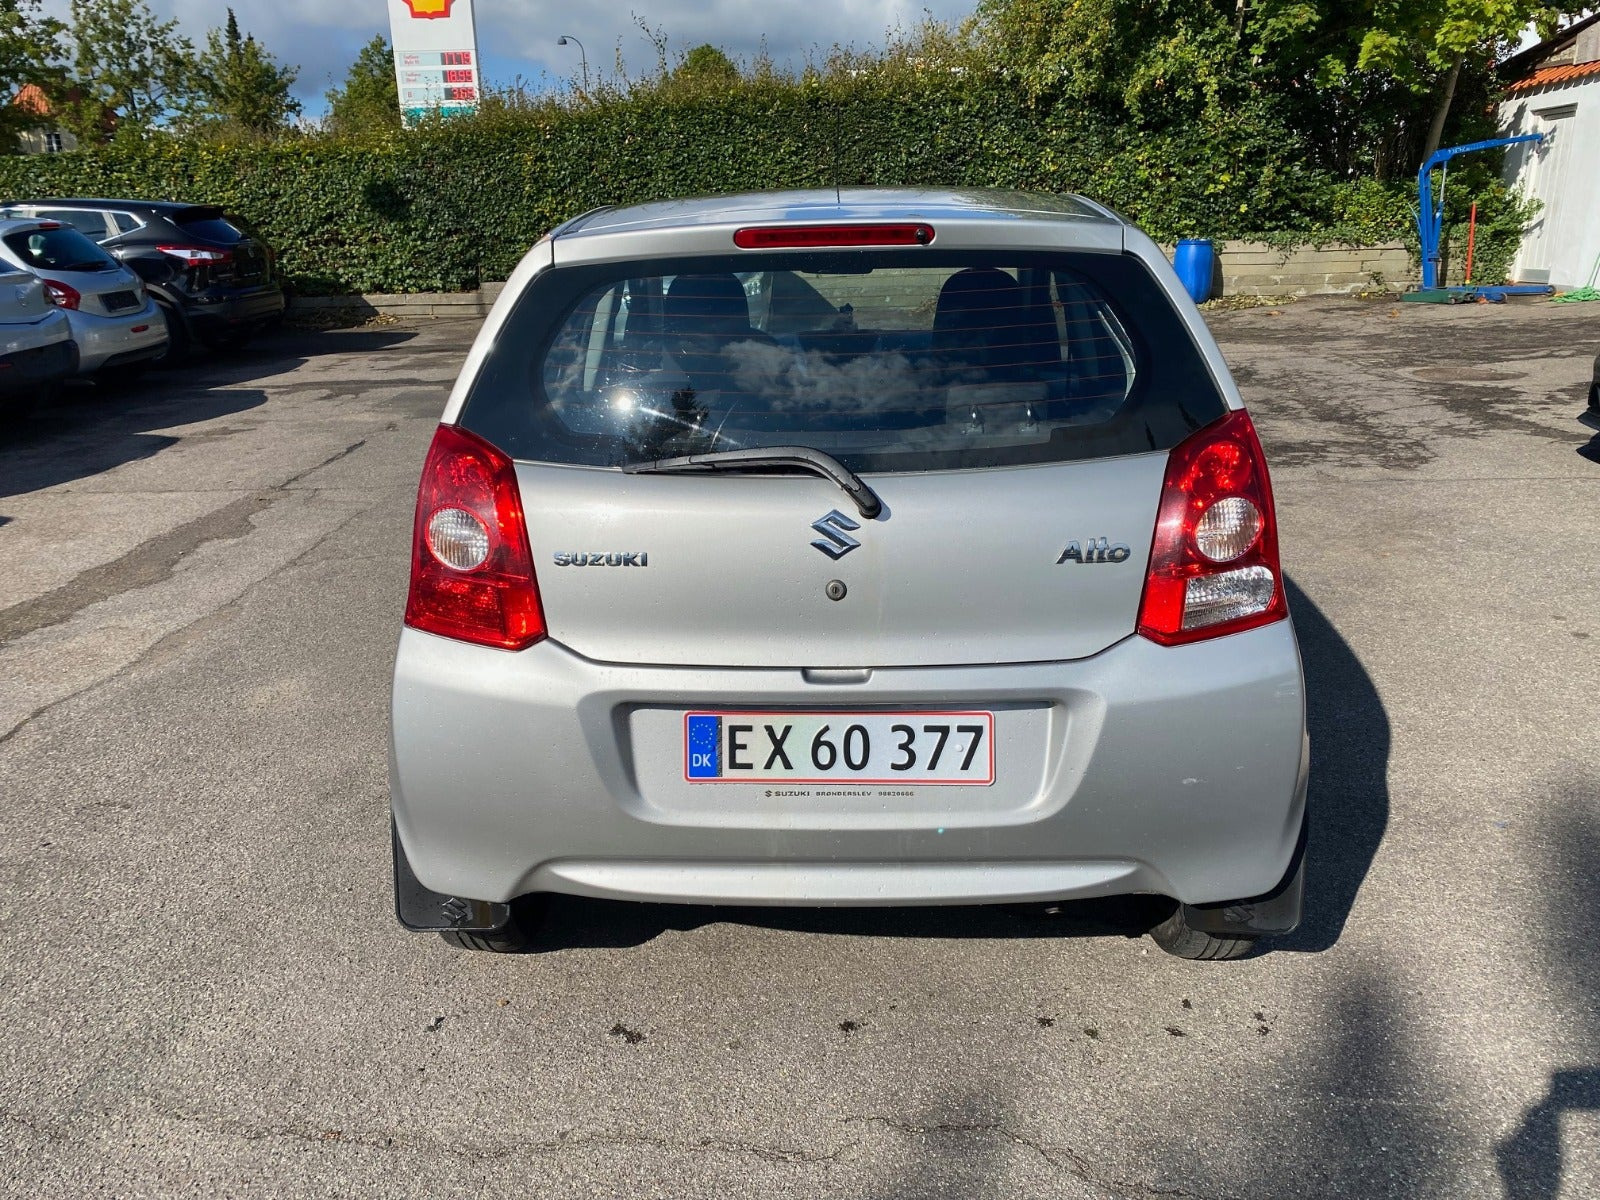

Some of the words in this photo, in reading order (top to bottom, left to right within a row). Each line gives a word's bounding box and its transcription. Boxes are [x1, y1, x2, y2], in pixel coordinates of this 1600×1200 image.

[1056, 536, 1131, 564] Alto
[553, 551, 648, 567] SUZUKI
[727, 724, 794, 771] EX
[810, 724, 870, 771] 60
[890, 724, 984, 771] 377
[692, 753, 712, 768] DK
[774, 790, 811, 798] SUZUKI
